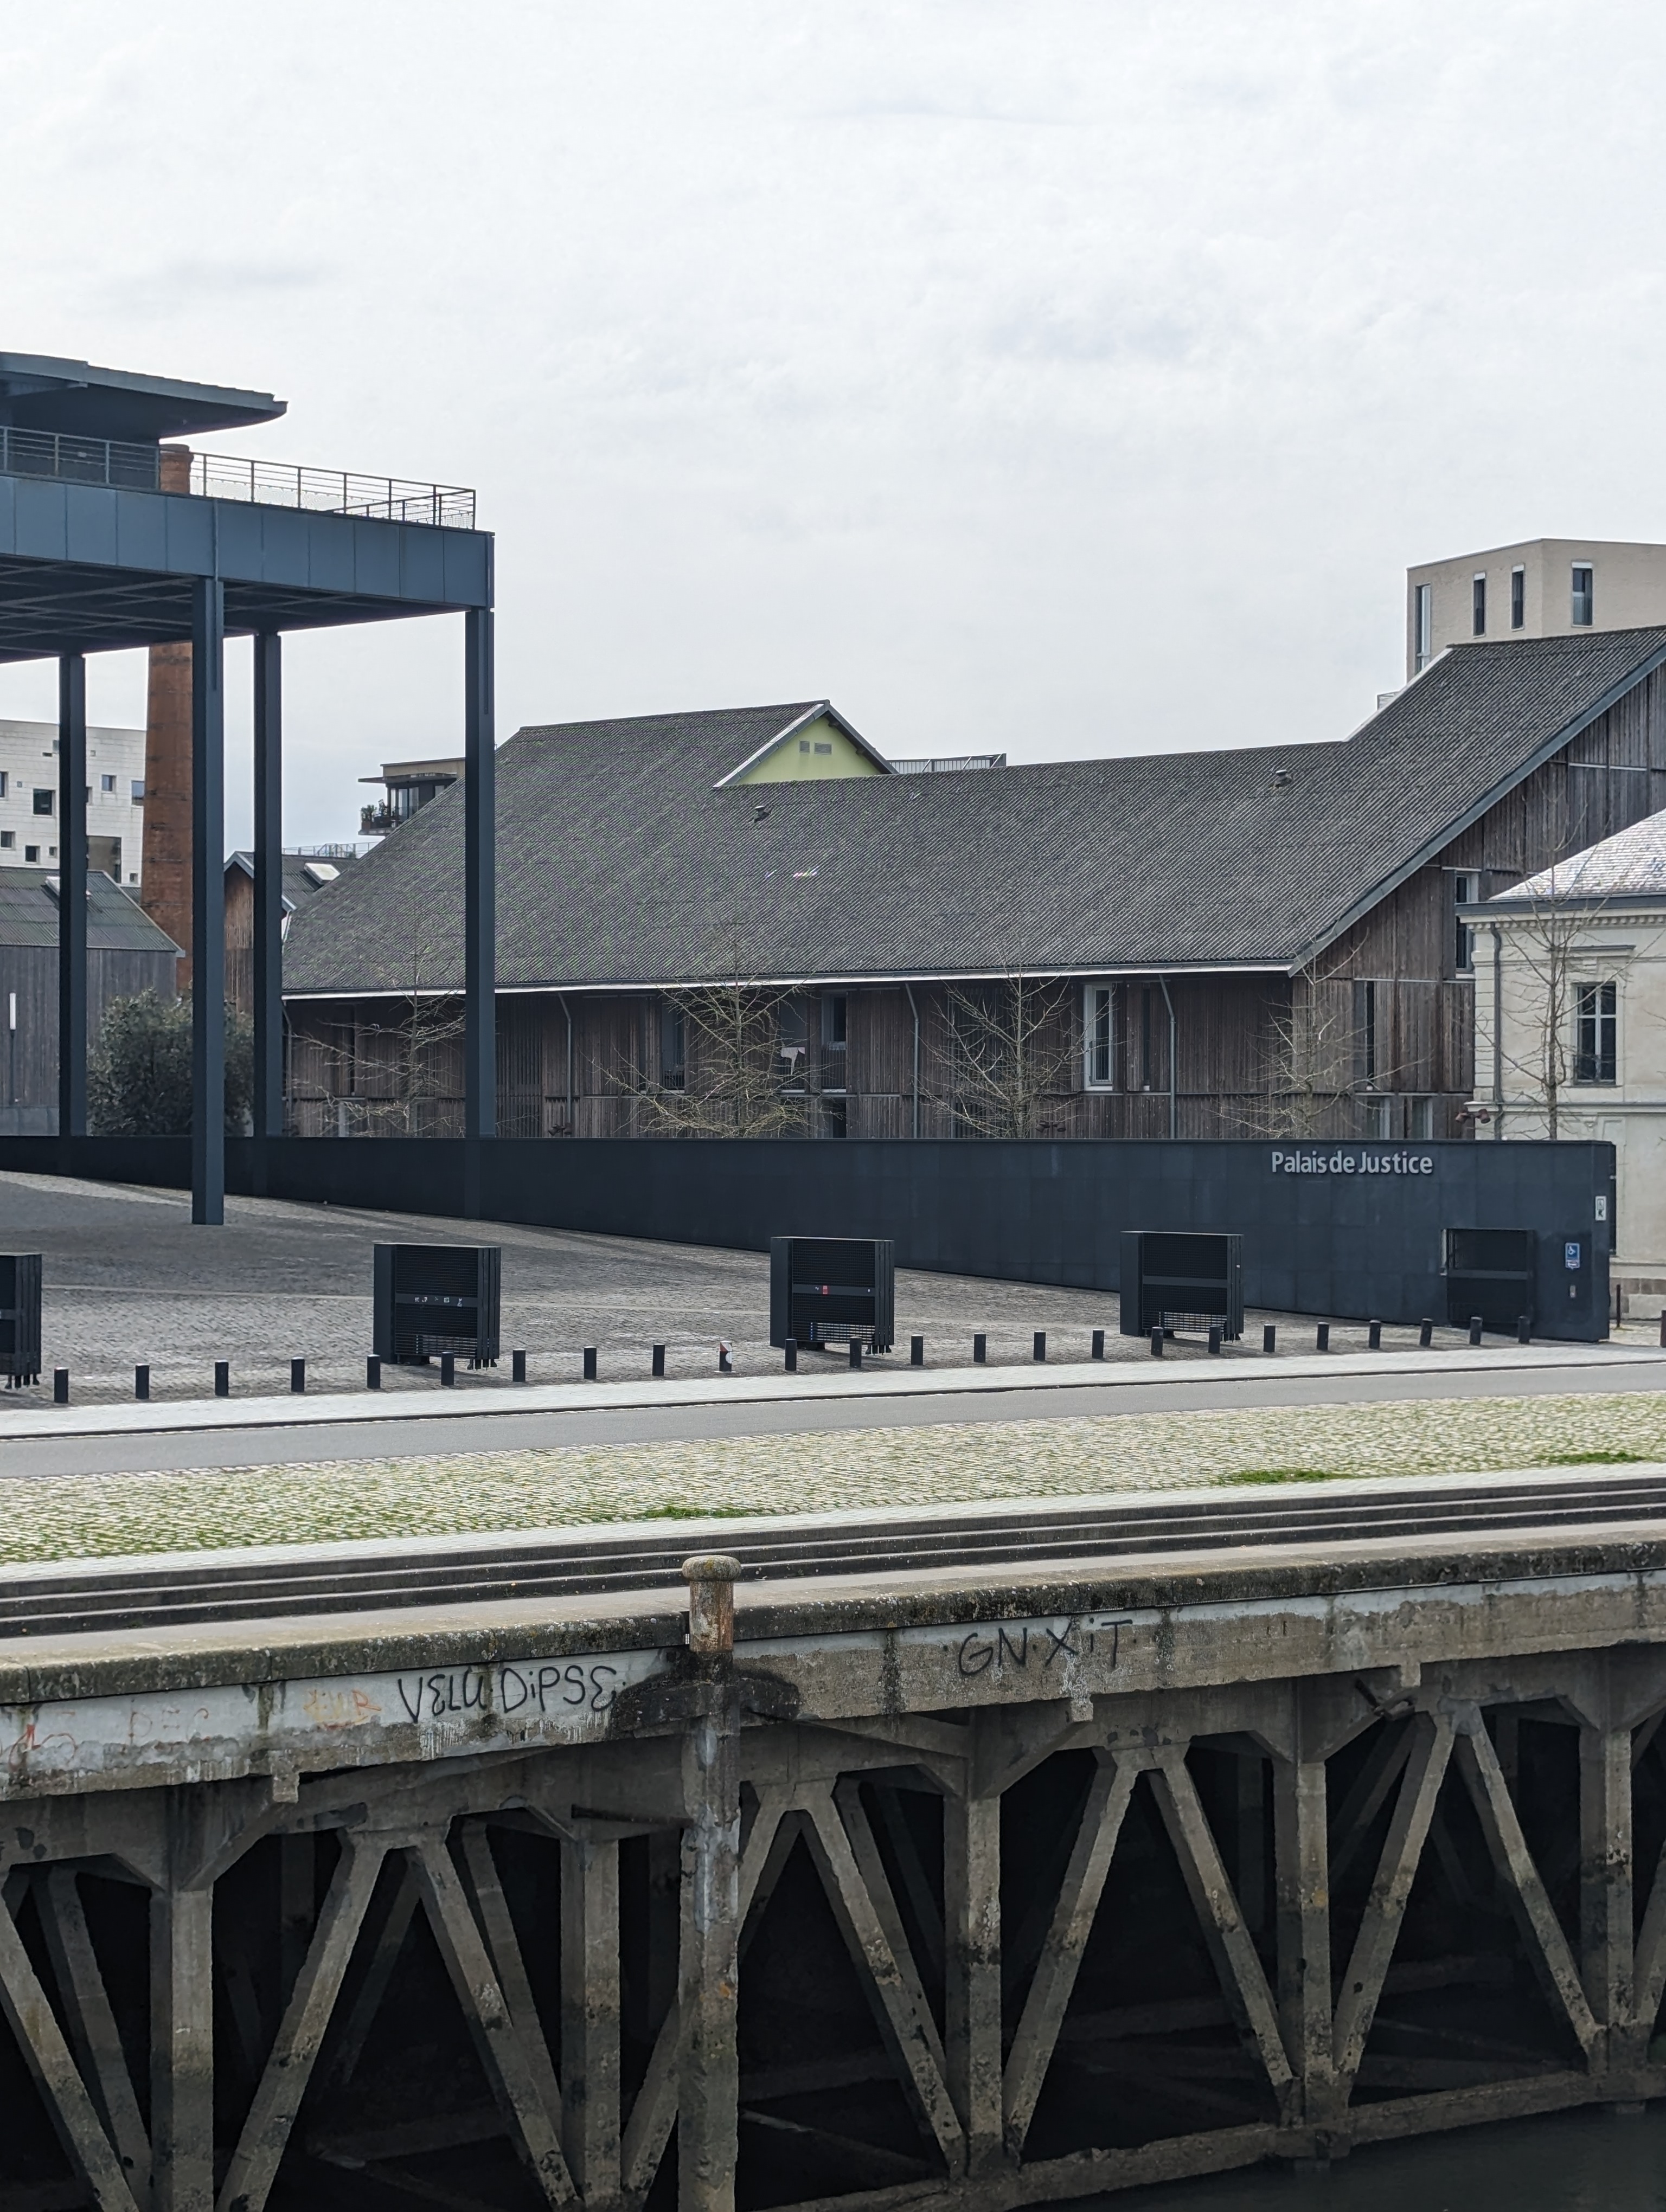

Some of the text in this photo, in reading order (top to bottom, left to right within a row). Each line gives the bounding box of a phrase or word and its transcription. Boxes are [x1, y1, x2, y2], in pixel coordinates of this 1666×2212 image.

[1271, 1150, 1433, 1174] Palais de Justice
